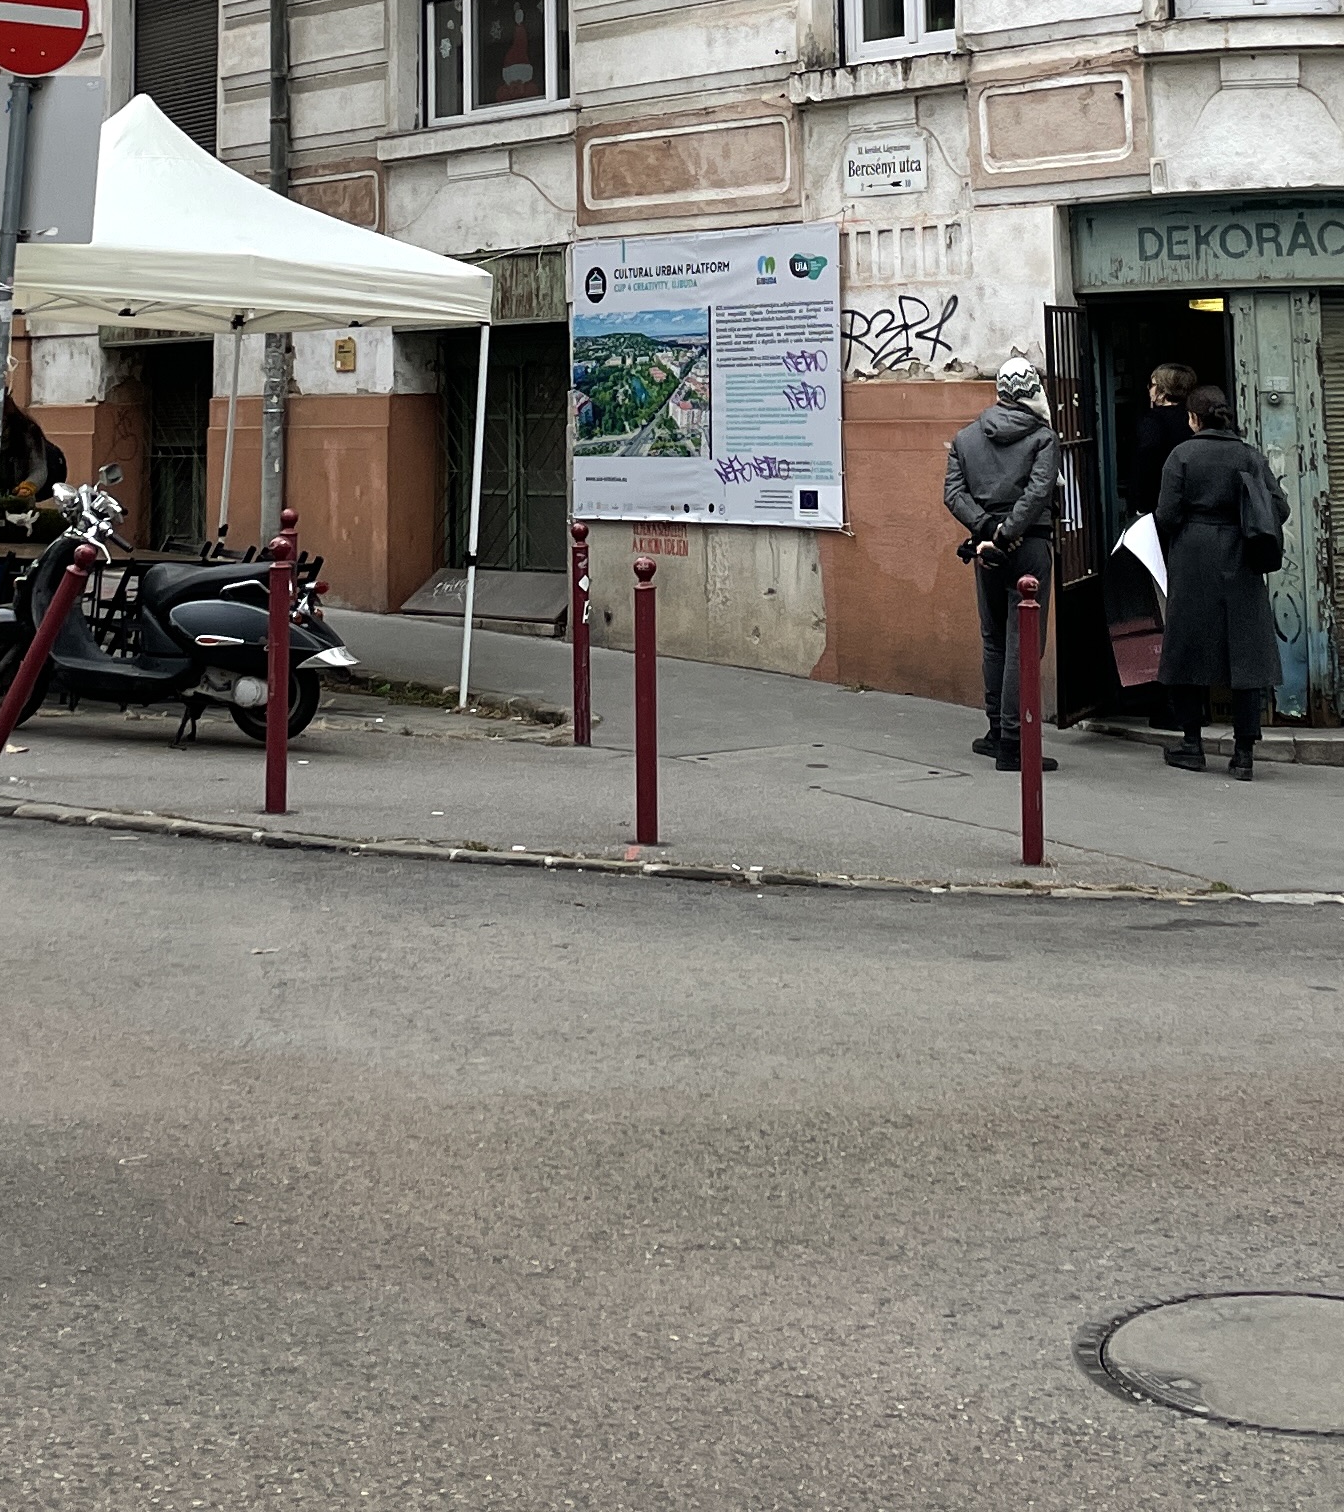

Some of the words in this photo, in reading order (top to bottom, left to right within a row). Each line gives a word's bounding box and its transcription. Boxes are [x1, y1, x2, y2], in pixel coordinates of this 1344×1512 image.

[848, 156, 896, 178] Bercsényi
[899, 156, 921, 173] utca
[614, 267, 653, 280] CULTURAL
[656, 264, 684, 277] URBAN
[686, 261, 730, 275] PLATFORM
